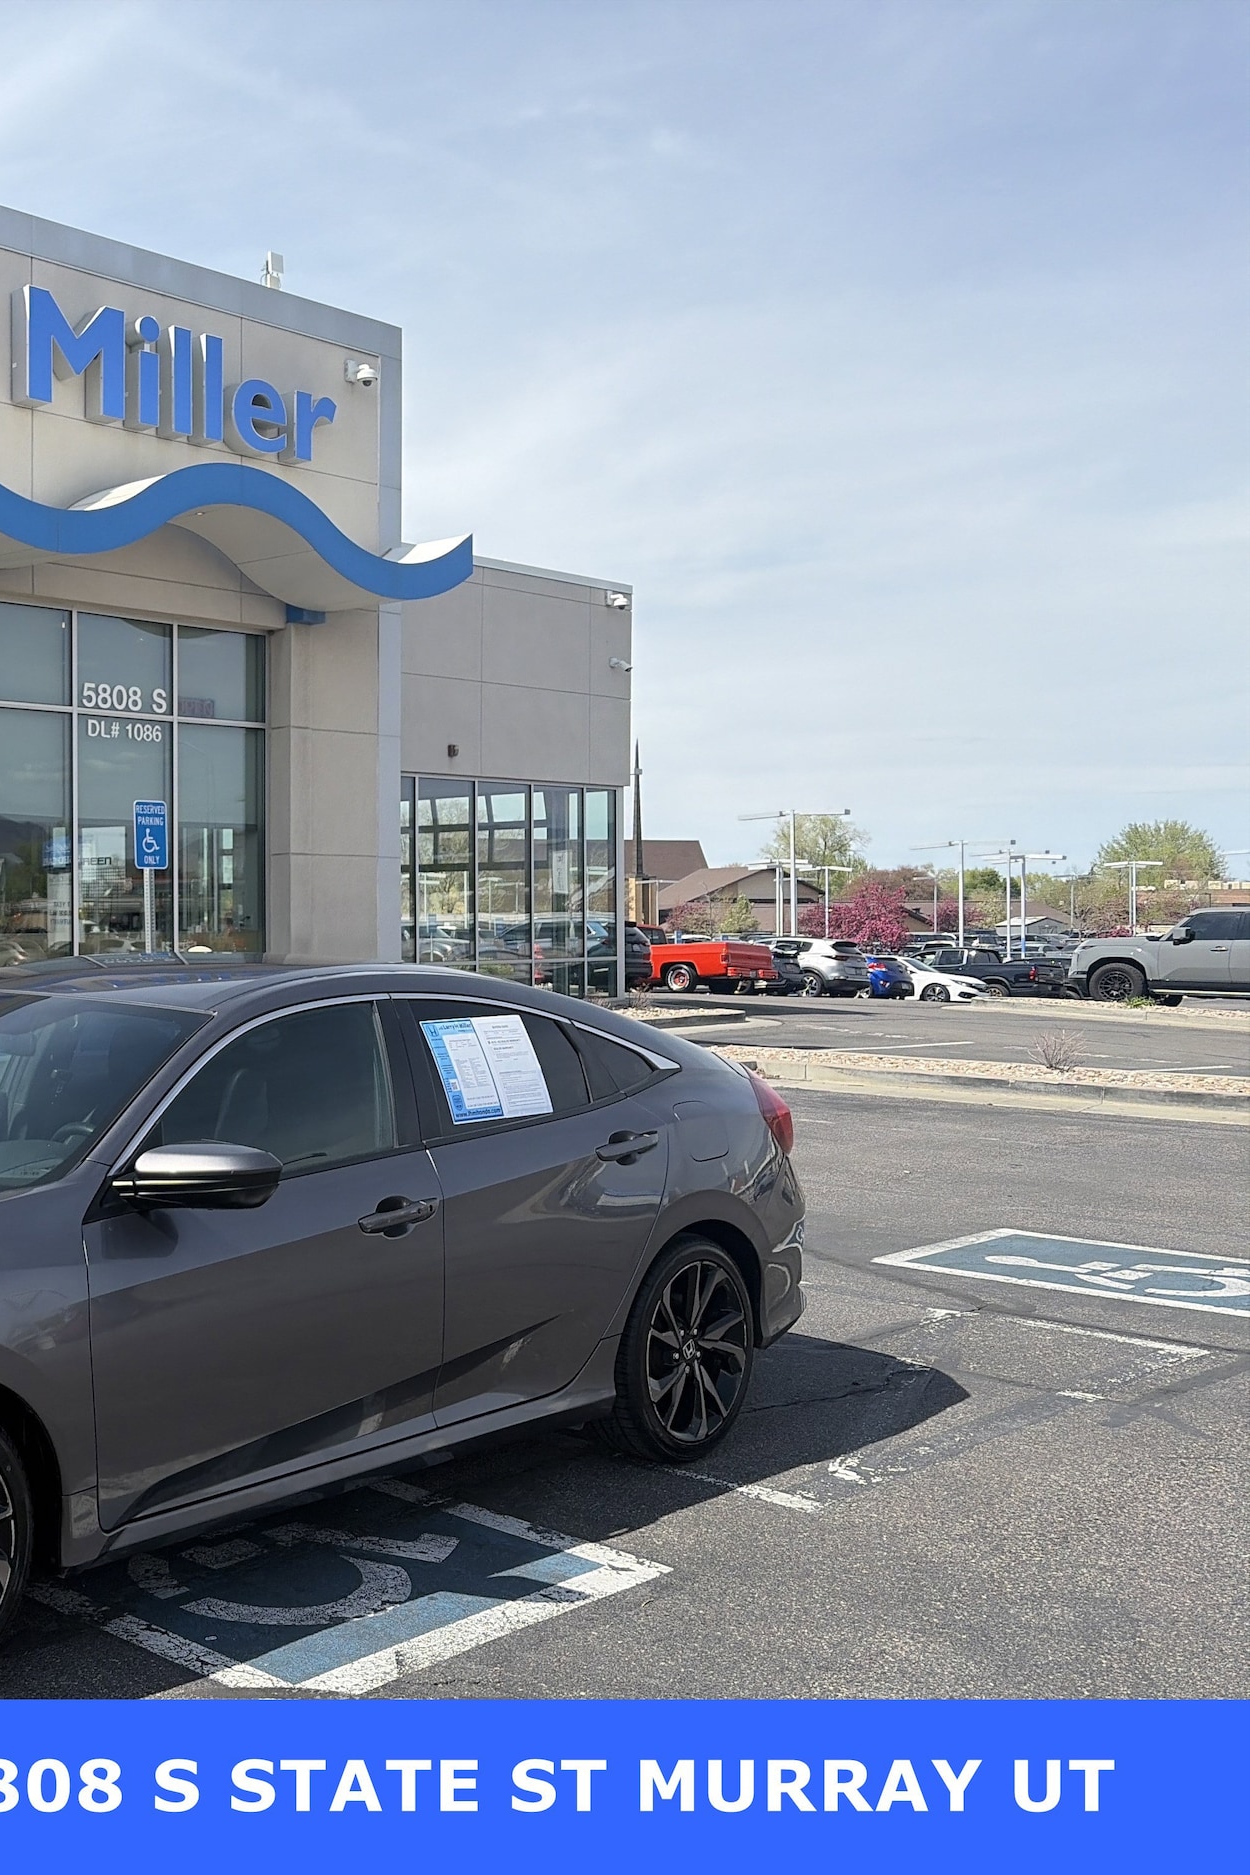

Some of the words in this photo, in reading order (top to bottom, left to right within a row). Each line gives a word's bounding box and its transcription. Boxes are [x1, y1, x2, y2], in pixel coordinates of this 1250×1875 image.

[13, 284, 337, 463] Miller
[82, 682, 142, 712] 5808
[152, 688, 167, 714] S
[87, 719, 120, 738] DL#
[125, 724, 162, 742] 1086
[136, 804, 165, 815] RESERVED
[137, 816, 164, 826] PARKING
[143, 855, 160, 865] ONLY
